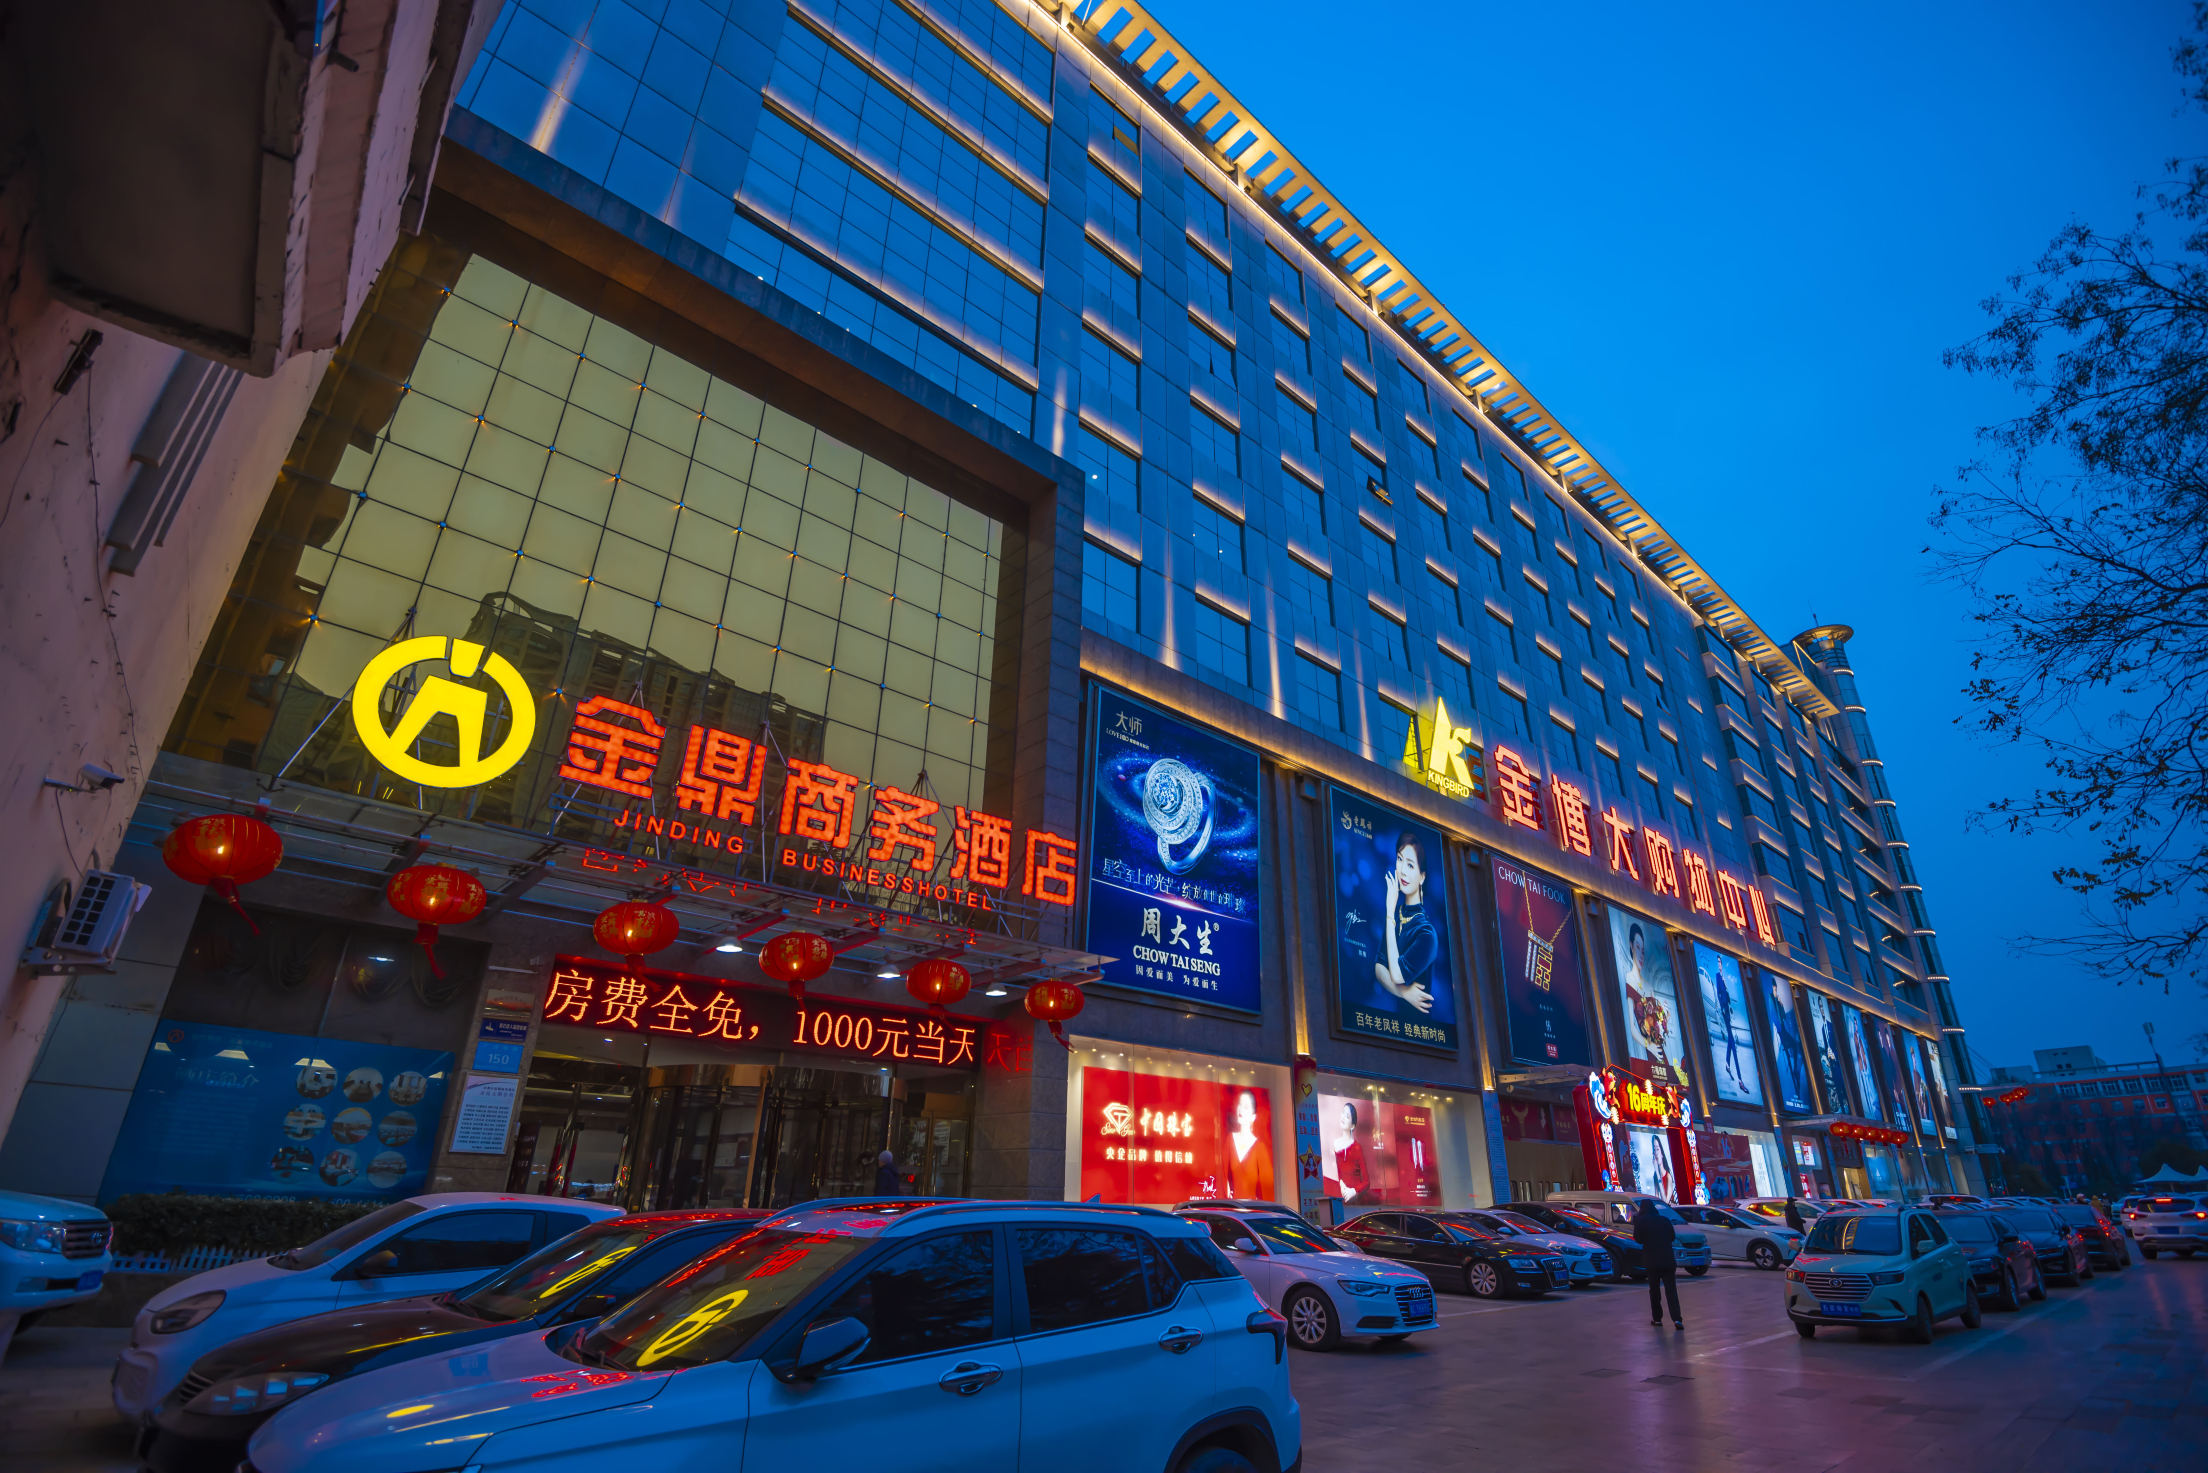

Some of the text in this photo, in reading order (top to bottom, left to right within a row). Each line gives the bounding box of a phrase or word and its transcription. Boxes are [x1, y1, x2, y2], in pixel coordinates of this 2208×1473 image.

[1115, 710, 1143, 736] 大师
[558, 694, 1078, 907] 金鼎商务酒店
[1427, 769, 1471, 799] KINGBIRD
[613, 808, 994, 914] JINDING BUSINESSHOTEL
[1494, 743, 1777, 947] 金博大购物中心
[1497, 865, 1567, 906] CHOW TAI FOOK
[1141, 907, 1214, 956] 周大生
[1132, 944, 1221, 977] CHOW TAI SENG
[545, 968, 977, 1066] 房费全免， 1000元当天
[1354, 1011, 1447, 1045] 百年老凤祥 经典新时尚
[487, 1052, 510, 1066] 150
[1626, 1082, 1668, 1116] 16周年庆
